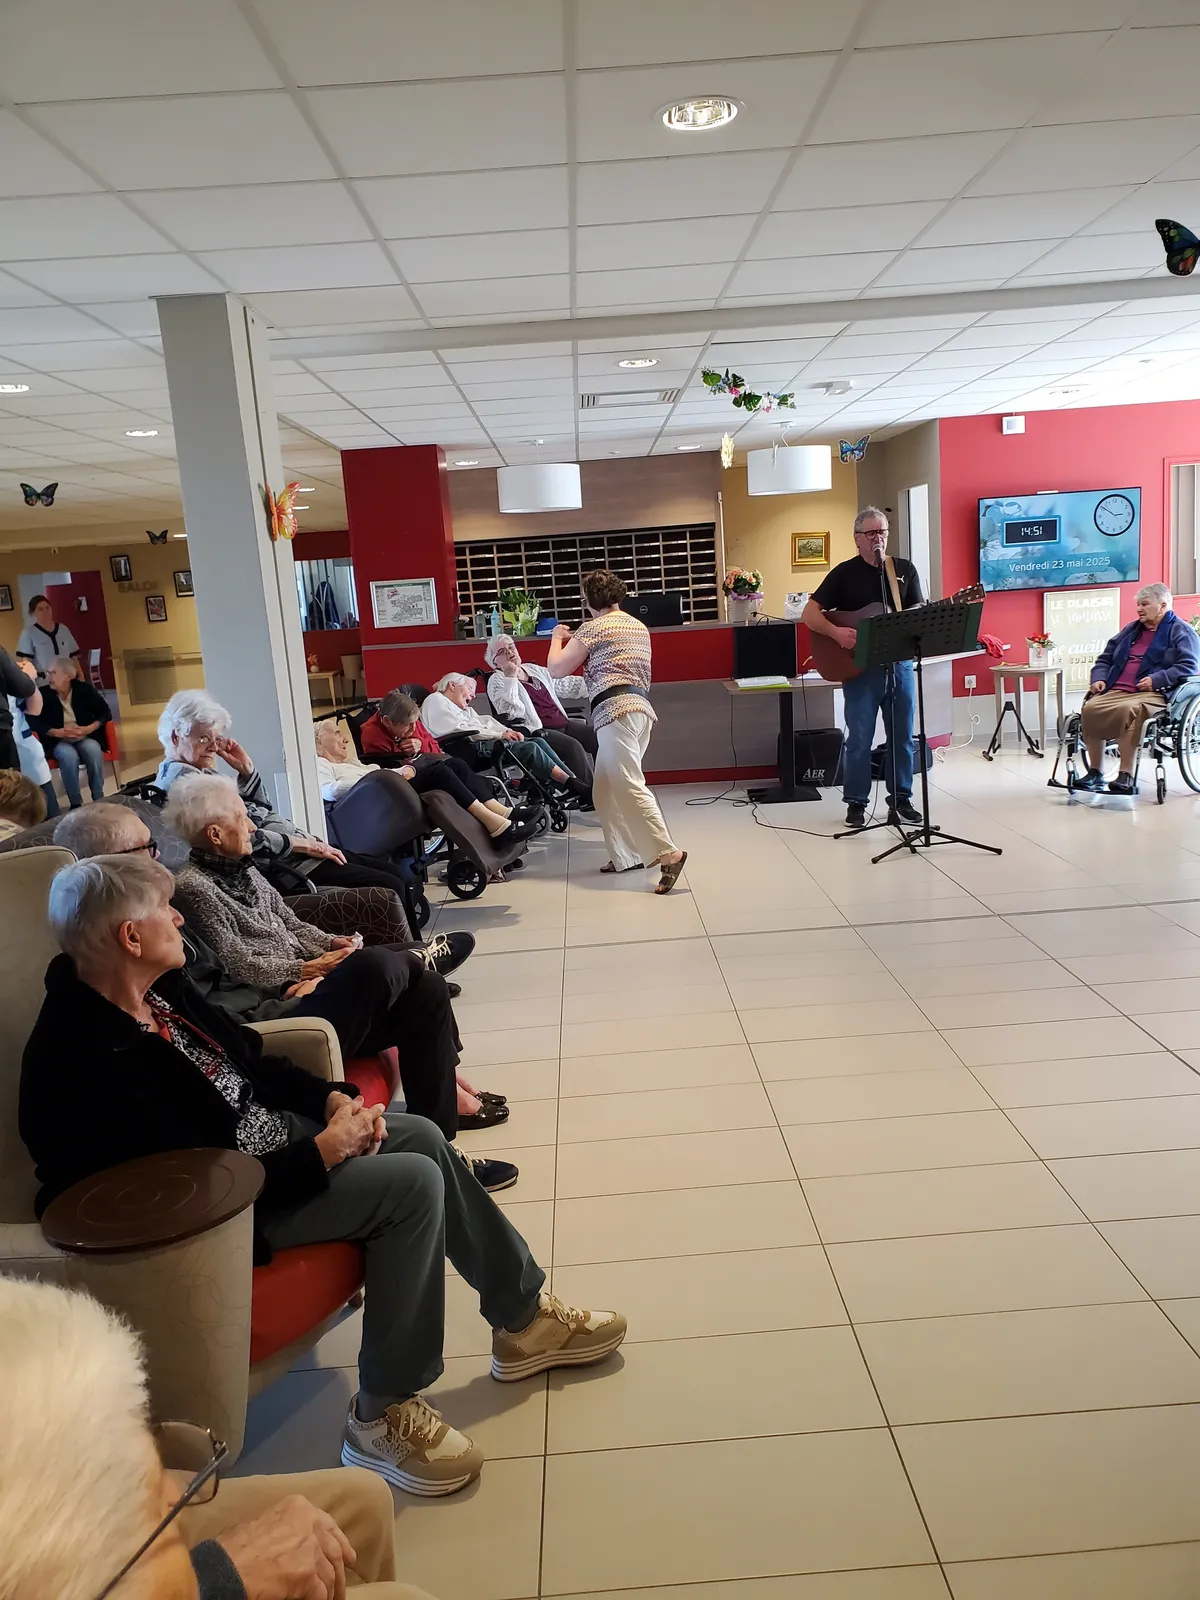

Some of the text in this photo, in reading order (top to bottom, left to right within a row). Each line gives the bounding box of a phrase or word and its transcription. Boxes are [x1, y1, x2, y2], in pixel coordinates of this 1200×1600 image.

[1021, 526, 1042, 536] 14:51
[1009, 556, 1111, 572] Vendredi 23 mai 2025
[1051, 597, 1114, 610] LE PLAISIR
[1068, 639, 1106, 655] cueill
